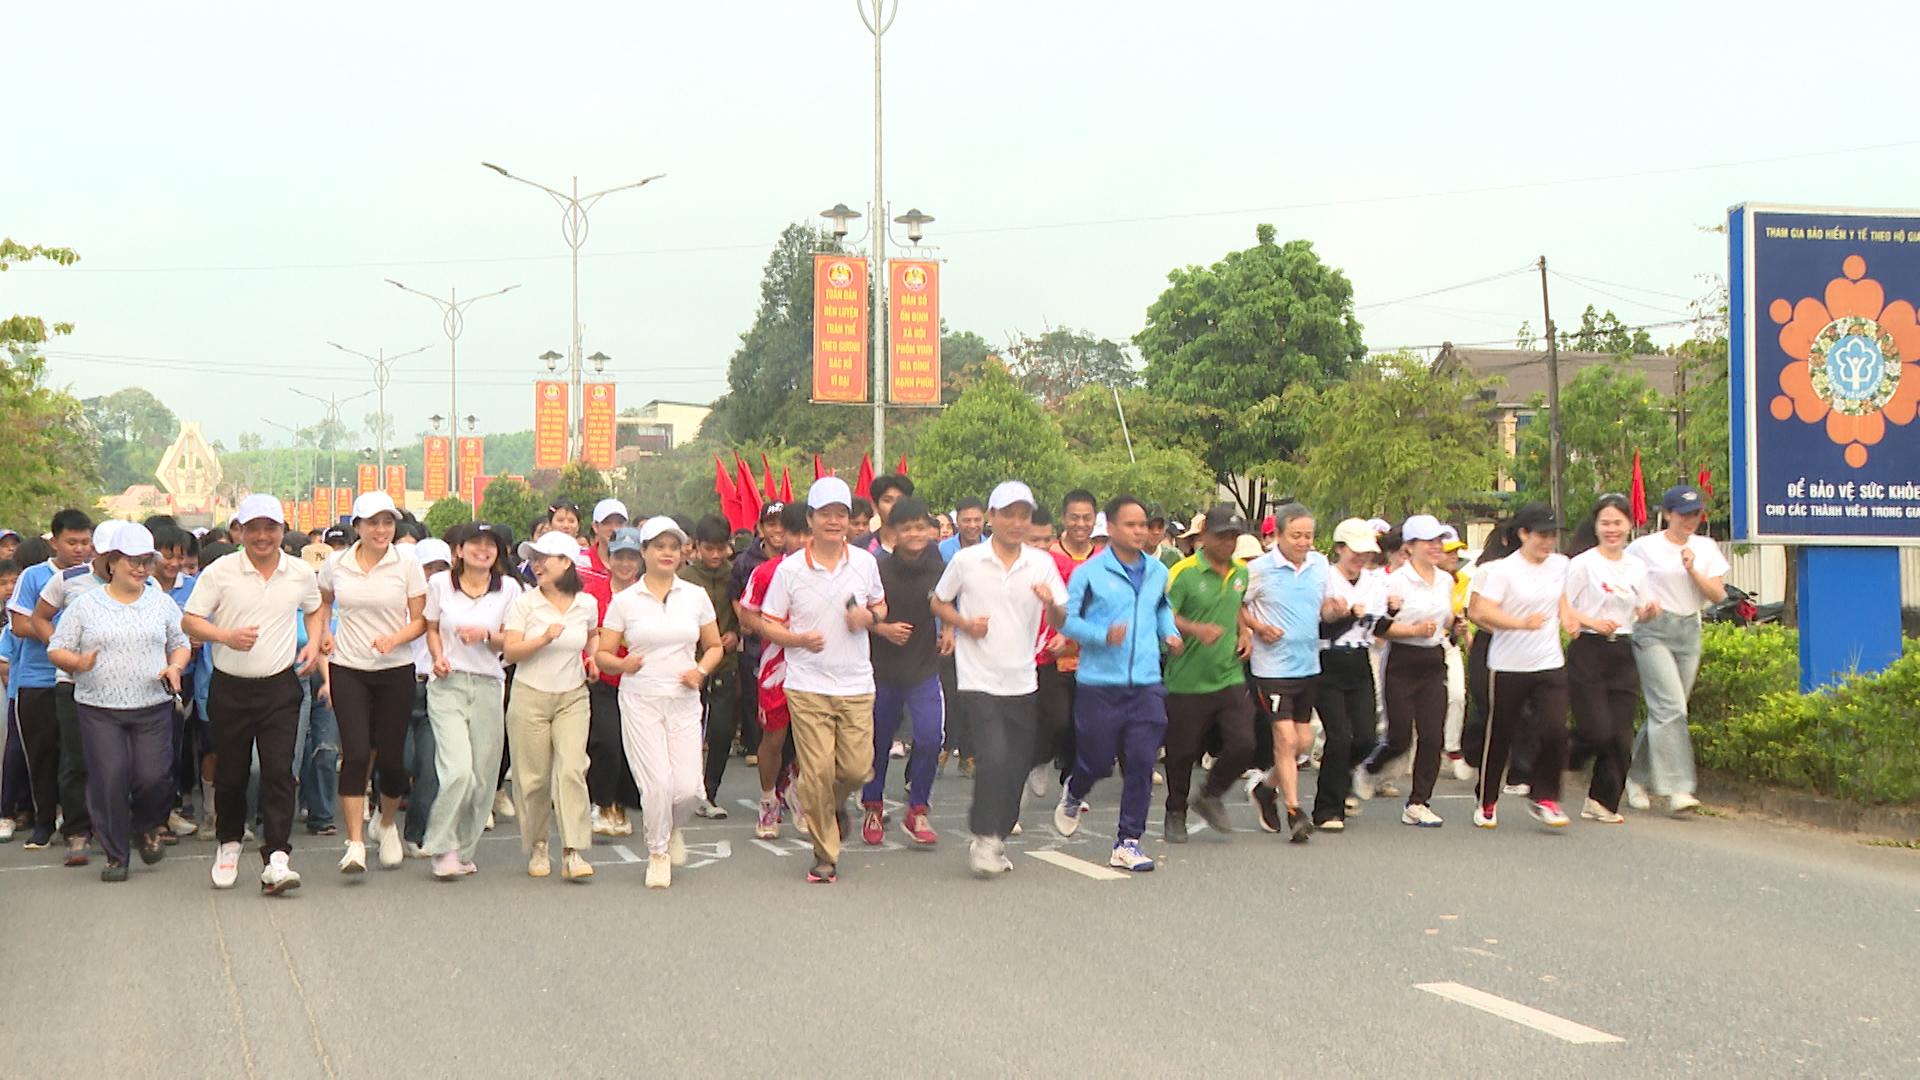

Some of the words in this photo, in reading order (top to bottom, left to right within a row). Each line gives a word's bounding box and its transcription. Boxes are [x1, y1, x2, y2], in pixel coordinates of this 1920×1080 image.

[1765, 226, 1788, 238] THAM
[1790, 227, 1804, 239] GIA
[1806, 225, 1824, 240] BẢO
[1825, 225, 1847, 240] HIỂM
[1849, 230, 1854, 240] Y
[1857, 227, 1868, 240] TẾ
[1870, 230, 1891, 241] THEO
[1893, 229, 1906, 243] HỘ
[1787, 477, 1805, 498] ĐỂ
[1809, 479, 1835, 498] BẢO
[1838, 481, 1856, 501] VỆ
[1859, 481, 1885, 499] SỨC
[1765, 504, 1786, 516] CHO
[1788, 502, 1808, 516] CÁC
[1810, 503, 1842, 517] THÀNH
[1845, 503, 1868, 517] VIÊN
[1871, 507, 1903, 518] TRONG
